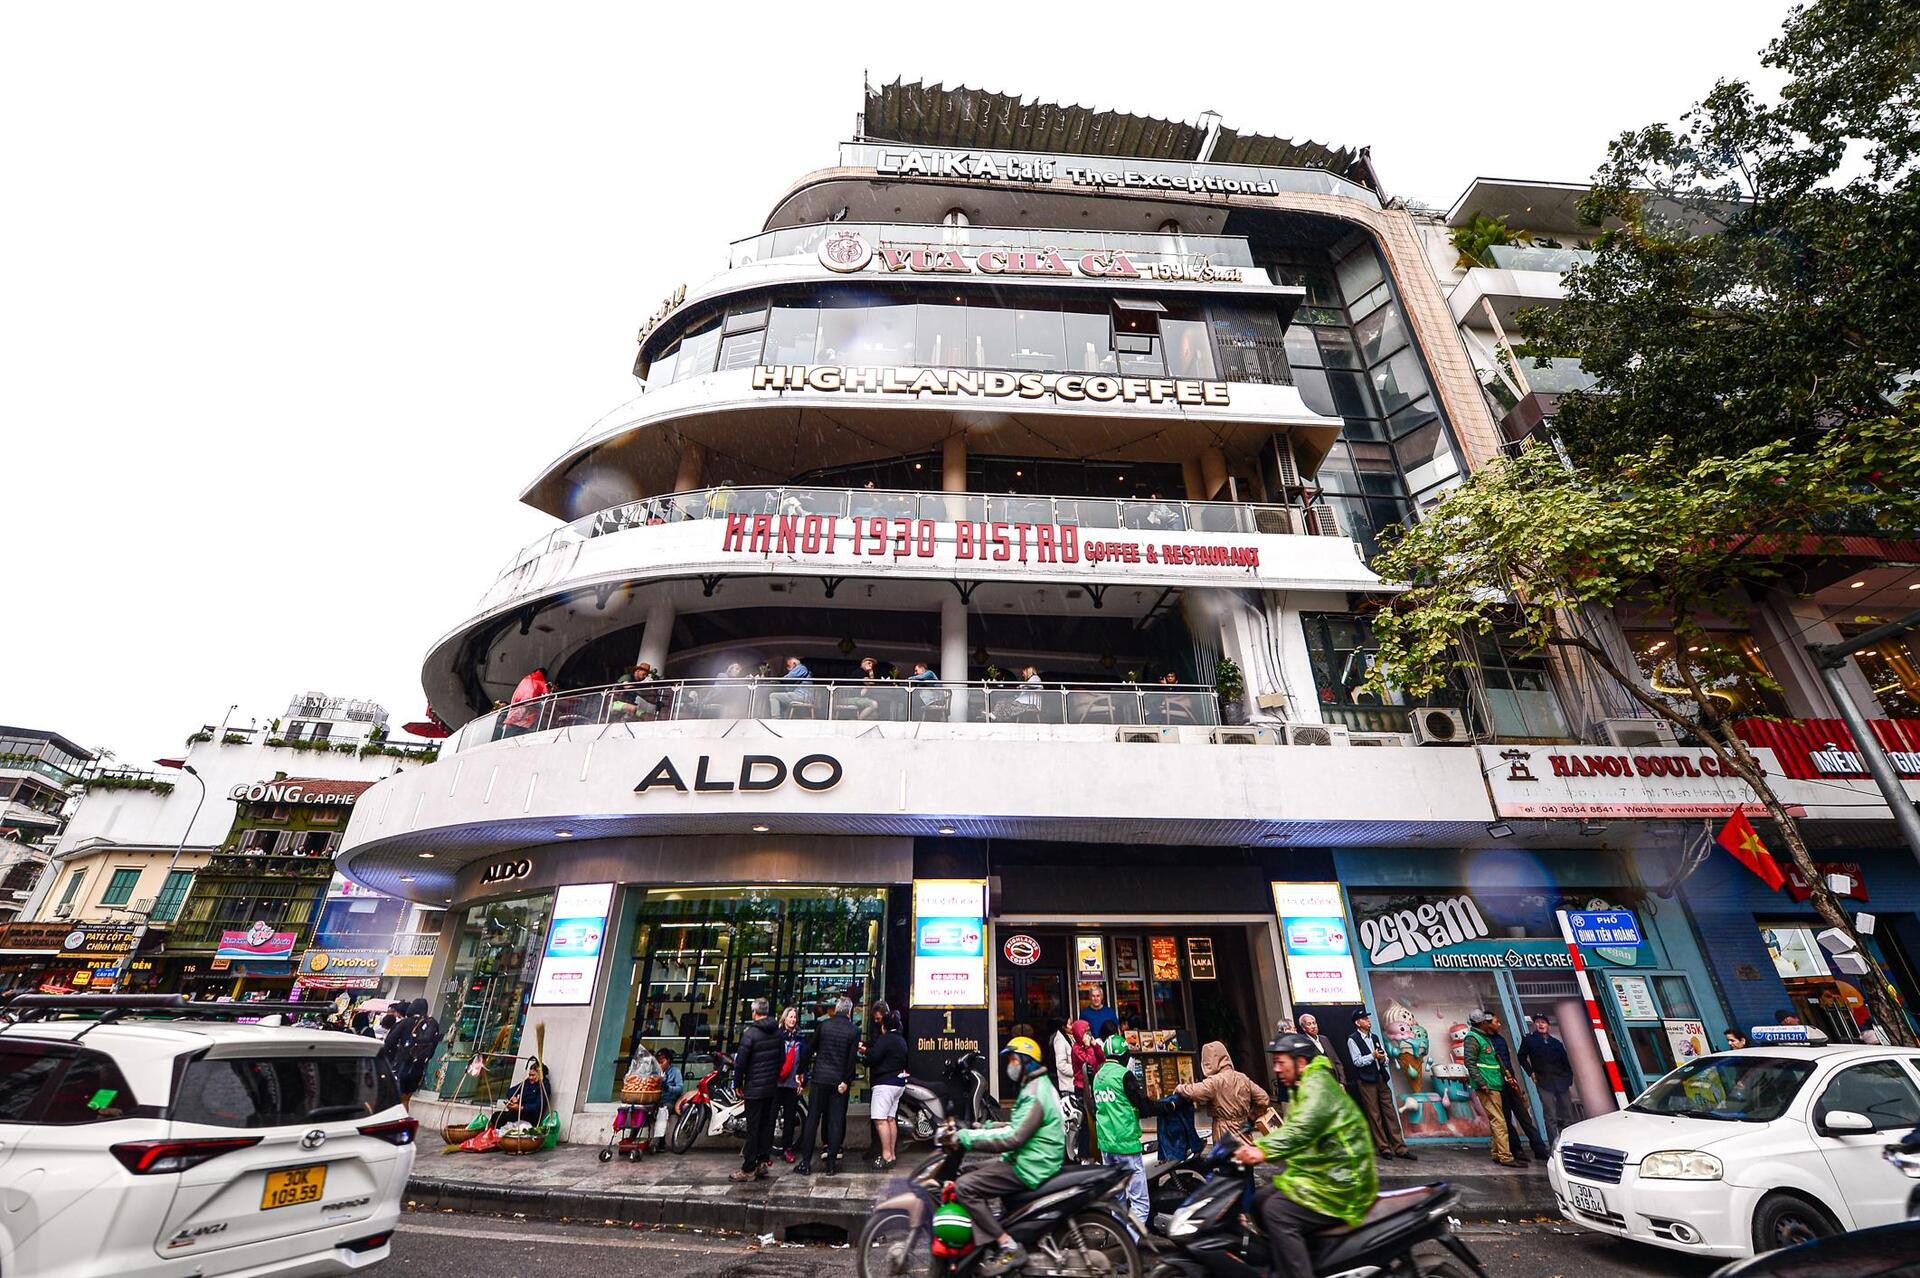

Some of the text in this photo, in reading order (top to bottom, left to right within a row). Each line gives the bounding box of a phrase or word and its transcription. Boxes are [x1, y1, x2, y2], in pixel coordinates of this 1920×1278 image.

[876, 150, 1280, 197] LAIKA Café The Exceptional
[879, 247, 972, 273] VUA
[752, 364, 1231, 406] HIGHLANDS COFFEE
[722, 512, 1261, 568] HANOI 1930 BISTRO COFFEE & RESTAURANT
[633, 753, 843, 794] ALDO
[1549, 755, 1767, 778] HANOI SOUL CA
[1539, 804, 1558, 814] (04)
[1561, 805, 1586, 814] 3934
[479, 859, 533, 885] ALDO
[1596, 913, 1618, 924] PHỐ
[85, 933, 105, 942] PATE
[1596, 927, 1614, 942] TIÊN
[1612, 927, 1637, 942] HOÀNG
[88, 961, 111, 969] PATE
[1009, 955, 1035, 966] COFFEE
[1192, 959, 1212, 967] LAIKA
[1432, 954, 1505, 968] HOMEMADE
[1524, 954, 1544, 967] ICE
[183, 965, 196, 973] 116
[943, 1011, 955, 1033] 1
[918, 1037, 935, 1051] Đinh
[284, 1169, 308, 1187] 30K
[271, 1184, 318, 1206] 109.59
